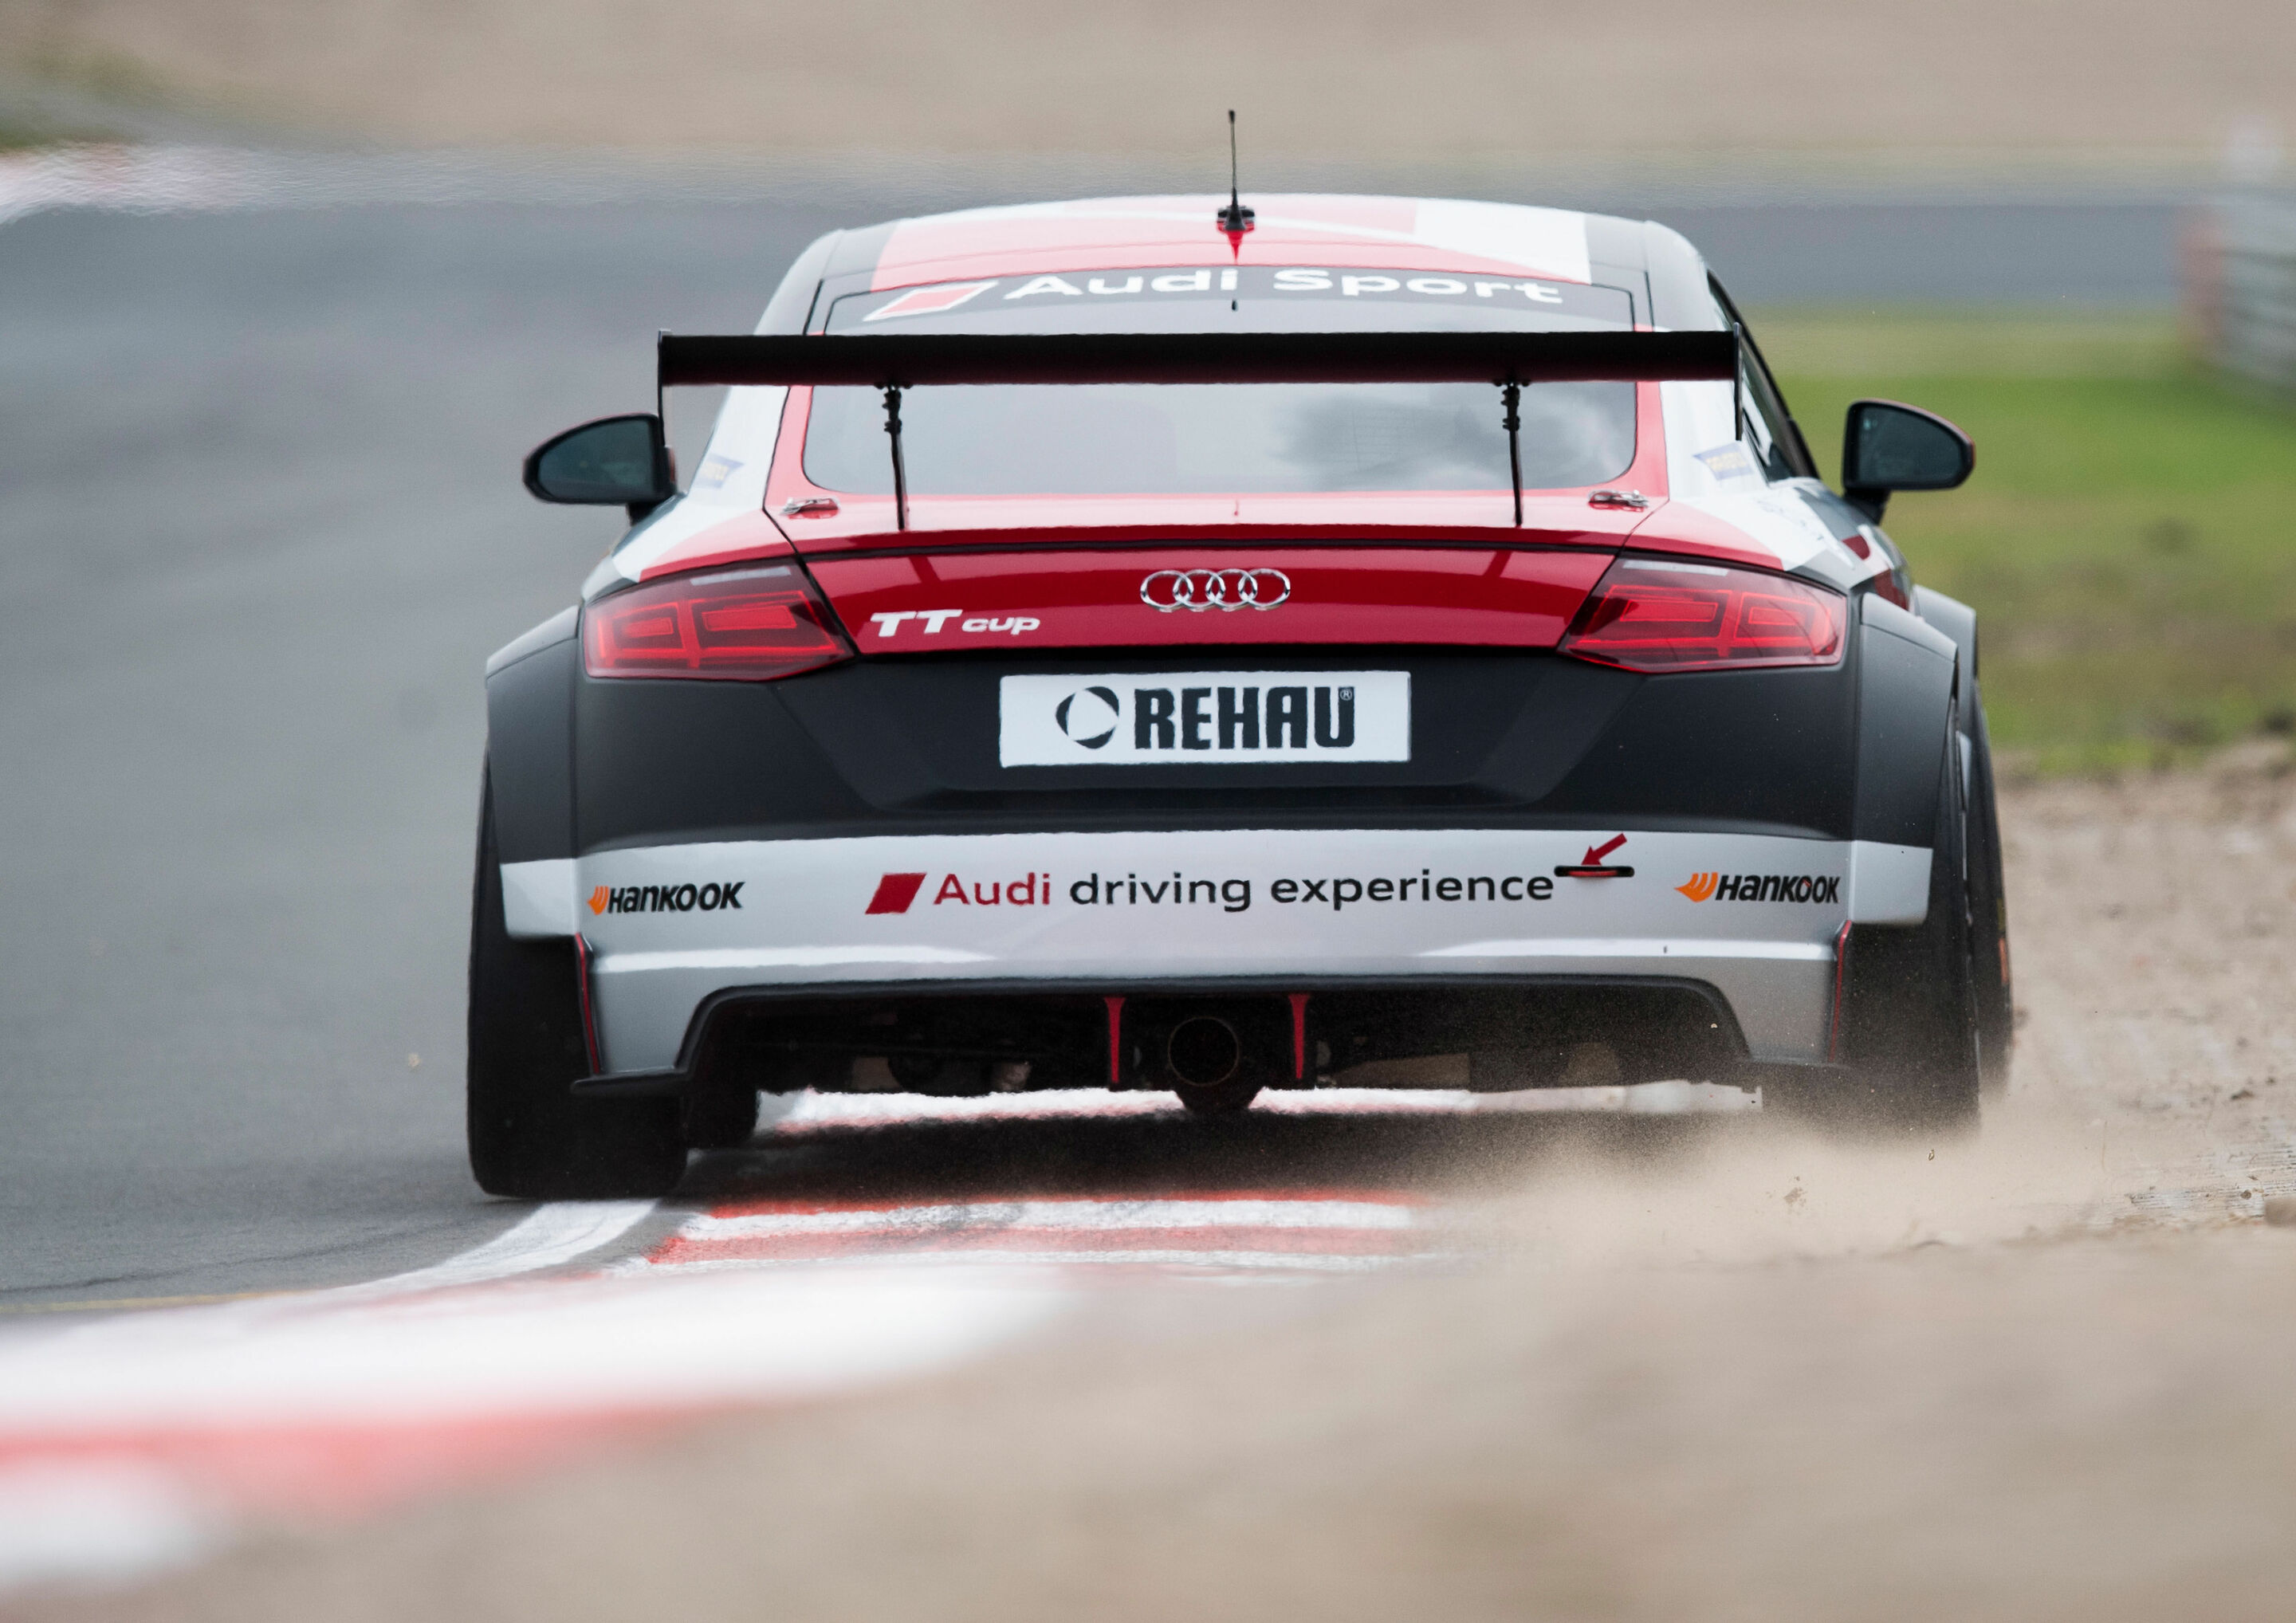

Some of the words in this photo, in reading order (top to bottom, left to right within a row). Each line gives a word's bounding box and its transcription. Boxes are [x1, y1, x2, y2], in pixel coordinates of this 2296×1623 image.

[1005, 269, 1238, 301] Audi
[1273, 269, 1564, 305] Sport
[870, 608, 963, 637] TT
[934, 872, 1052, 906] Audi
[1070, 871, 1251, 912] driving
[1271, 868, 1555, 911] experience
